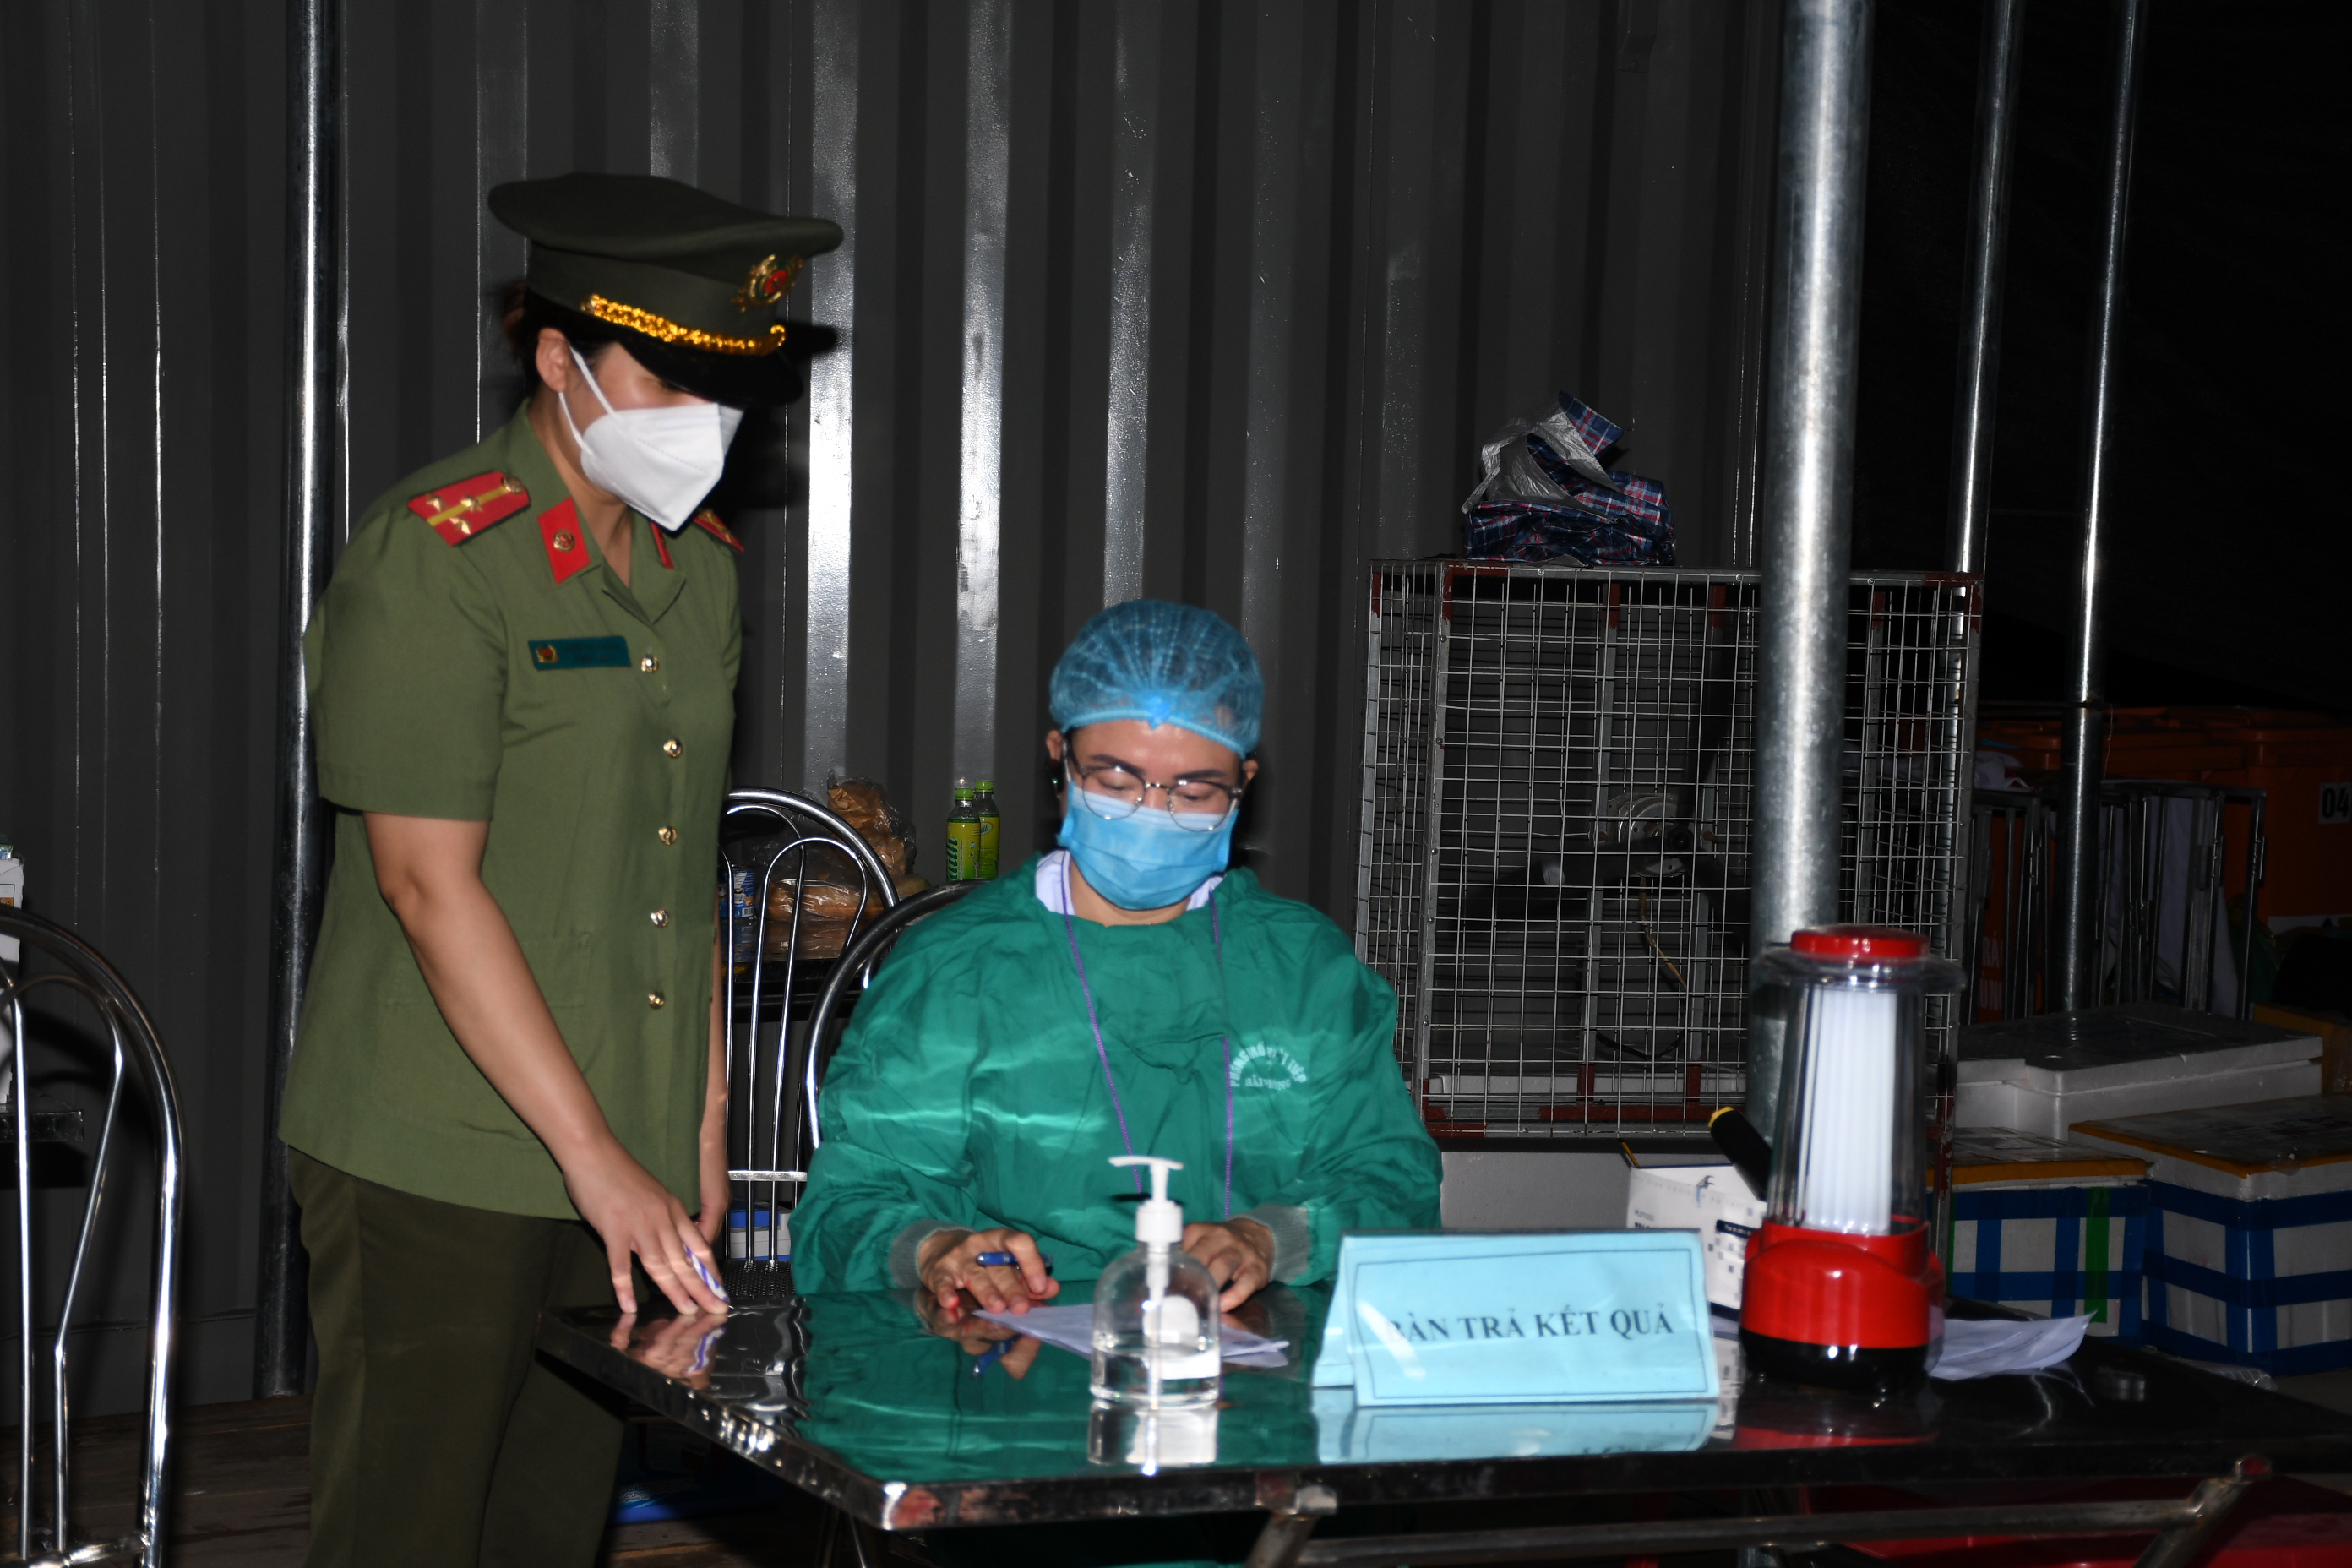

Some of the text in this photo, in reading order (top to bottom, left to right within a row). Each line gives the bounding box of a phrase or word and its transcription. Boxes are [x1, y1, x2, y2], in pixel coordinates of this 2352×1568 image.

[2322, 787, 2349, 819] 04
[1456, 1308, 1526, 1340] TRẢ
[1534, 1304, 1600, 1338] KẾT
[1609, 1302, 1674, 1340] QUẢ
